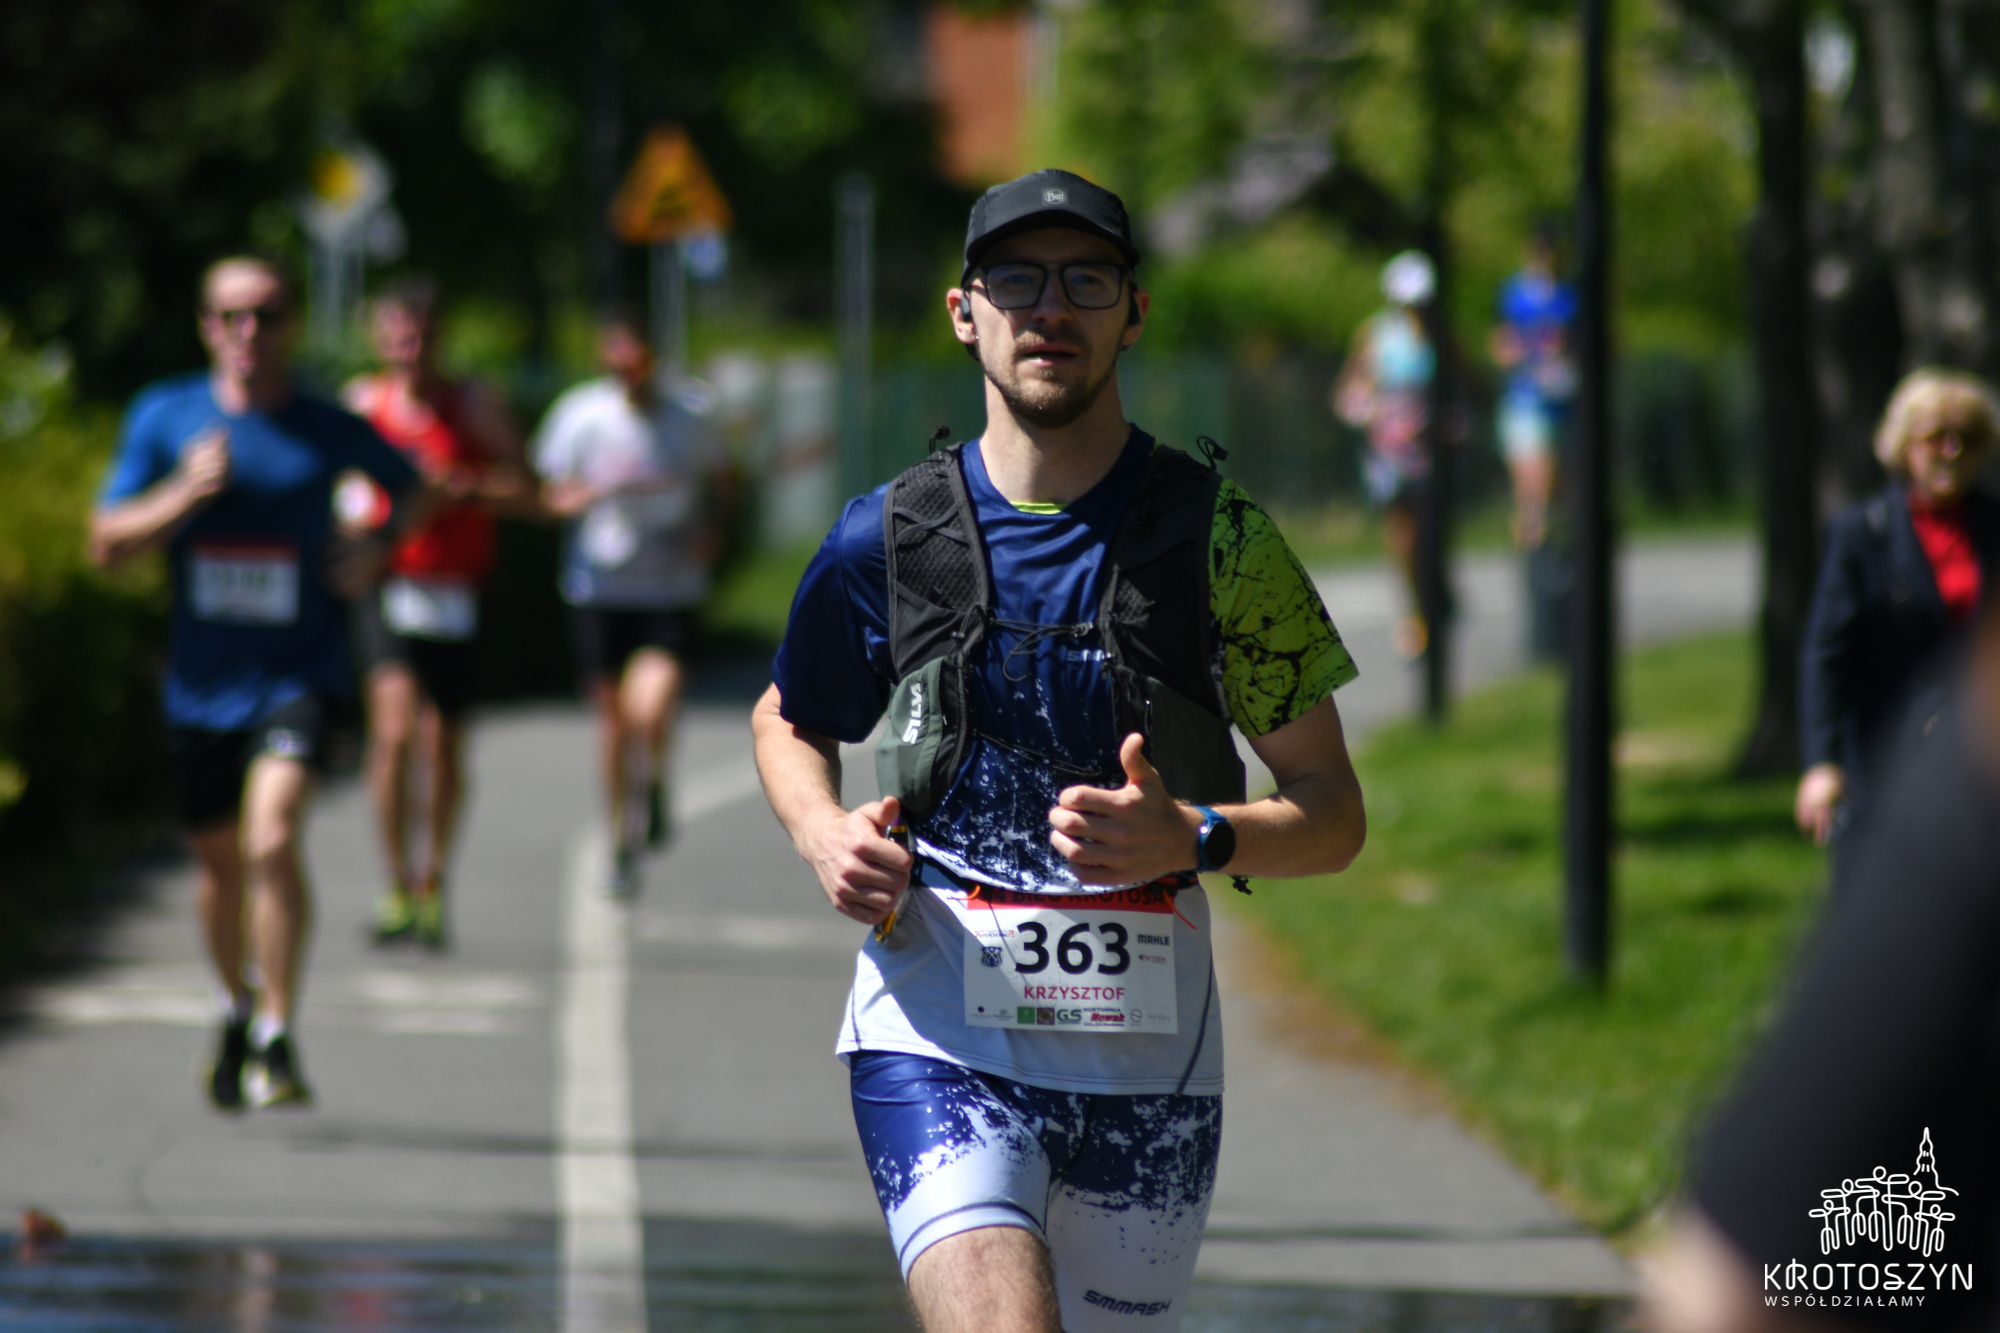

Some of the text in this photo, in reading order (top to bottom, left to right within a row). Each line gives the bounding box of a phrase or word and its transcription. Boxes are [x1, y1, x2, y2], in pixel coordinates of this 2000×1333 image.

[902, 682, 922, 744] SILVA
[1137, 934, 1170, 946] MAHLE
[1015, 921, 1131, 975] 363
[1024, 986, 1125, 1000] KRZYSZTOF
[1056, 1008, 1082, 1021] GS
[1090, 1013, 1125, 1022] Nowak
[1083, 1289, 1172, 1315] SMMASH
